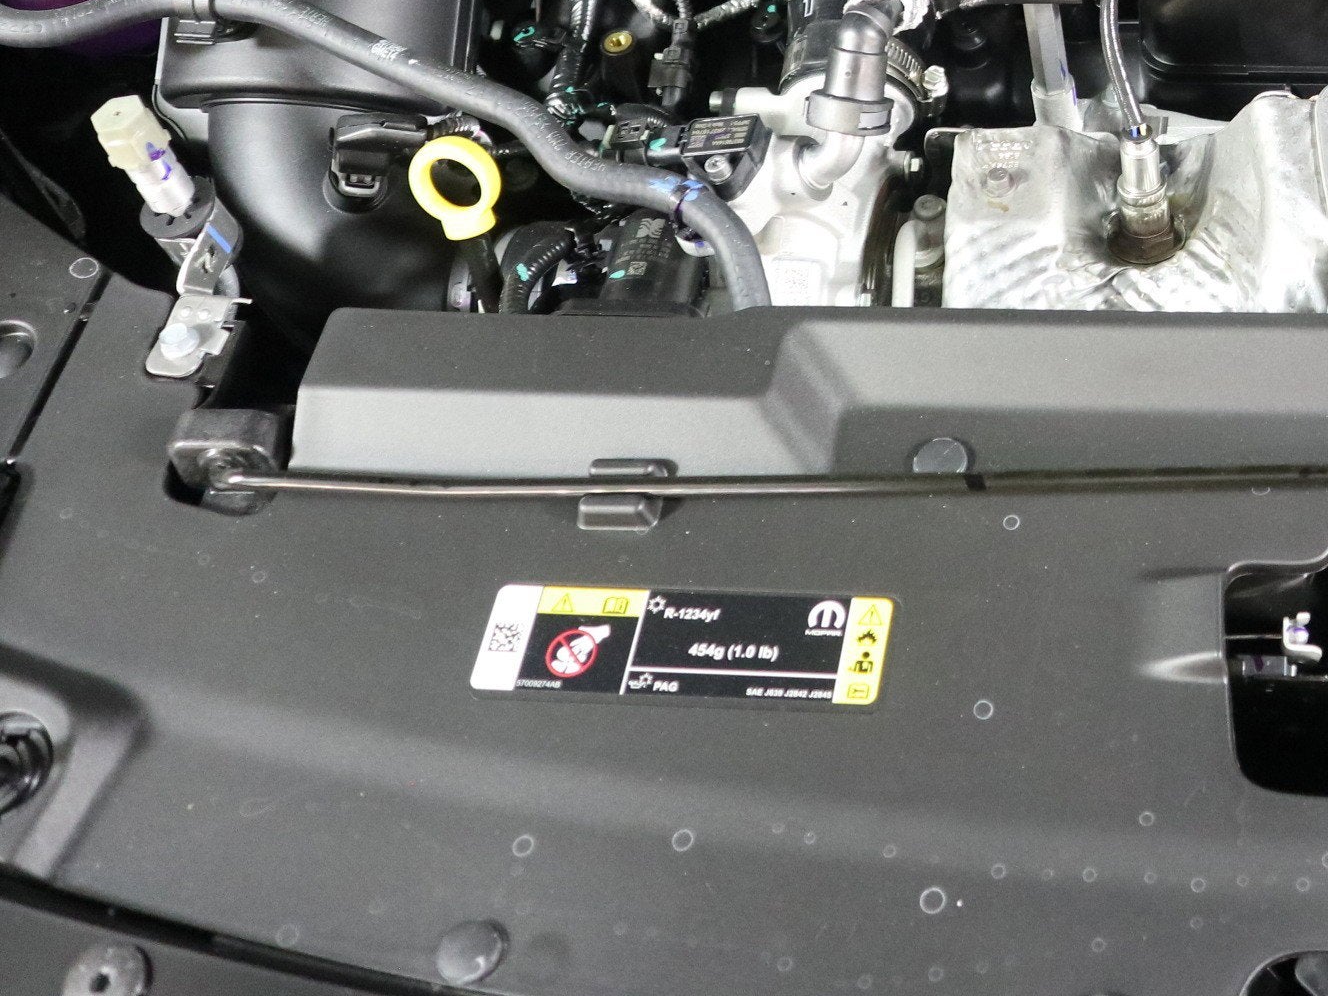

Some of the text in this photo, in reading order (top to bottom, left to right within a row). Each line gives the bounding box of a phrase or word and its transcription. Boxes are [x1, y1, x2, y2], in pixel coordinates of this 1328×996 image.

[663, 606, 721, 623] R-1234yf
[688, 642, 780, 662] 454g (1.0 lb)
[653, 680, 680, 693] PAG
[745, 687, 764, 697] SAE
[764, 688, 784, 697] J639
[784, 688, 808, 698] J2842
